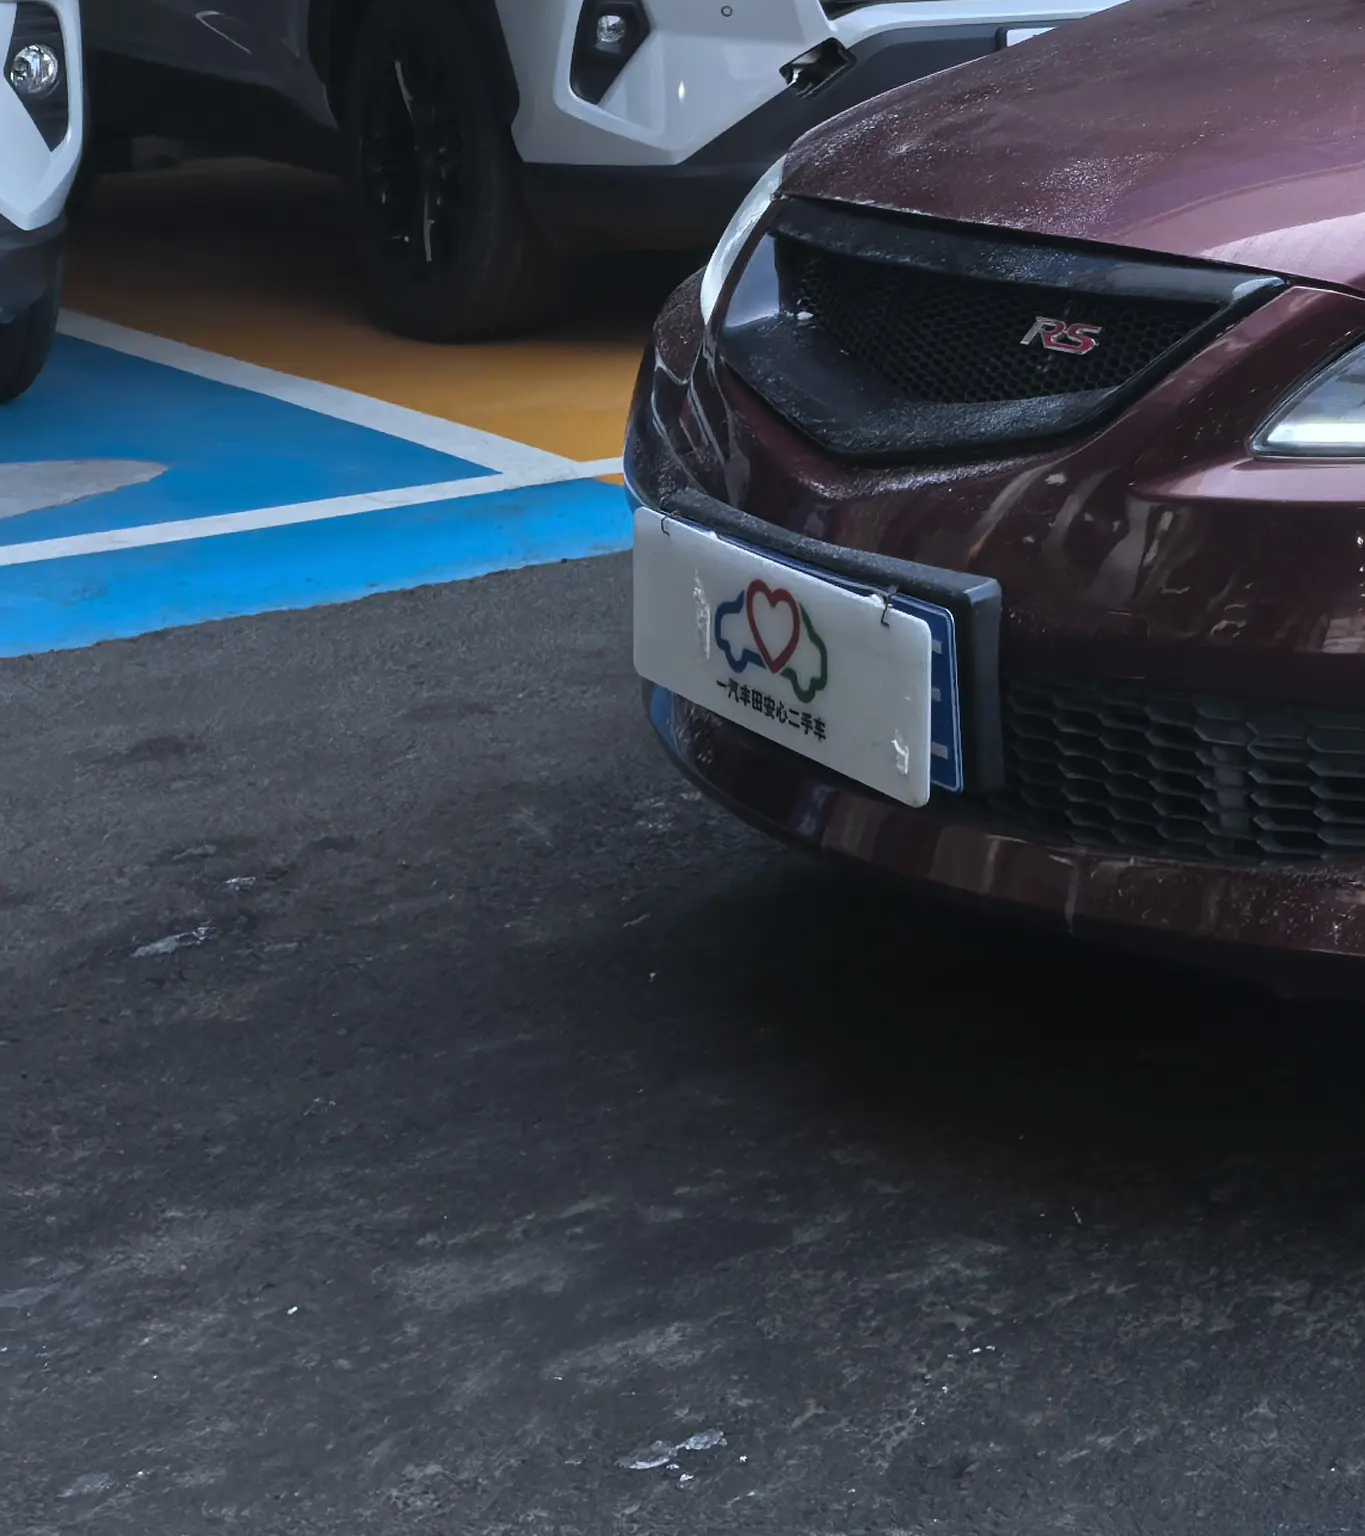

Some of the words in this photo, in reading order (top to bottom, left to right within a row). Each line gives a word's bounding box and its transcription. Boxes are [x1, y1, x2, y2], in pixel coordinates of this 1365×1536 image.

[1020, 315, 1102, 355] RS
[715, 678, 827, 742] 一汽丰田安心二手车
